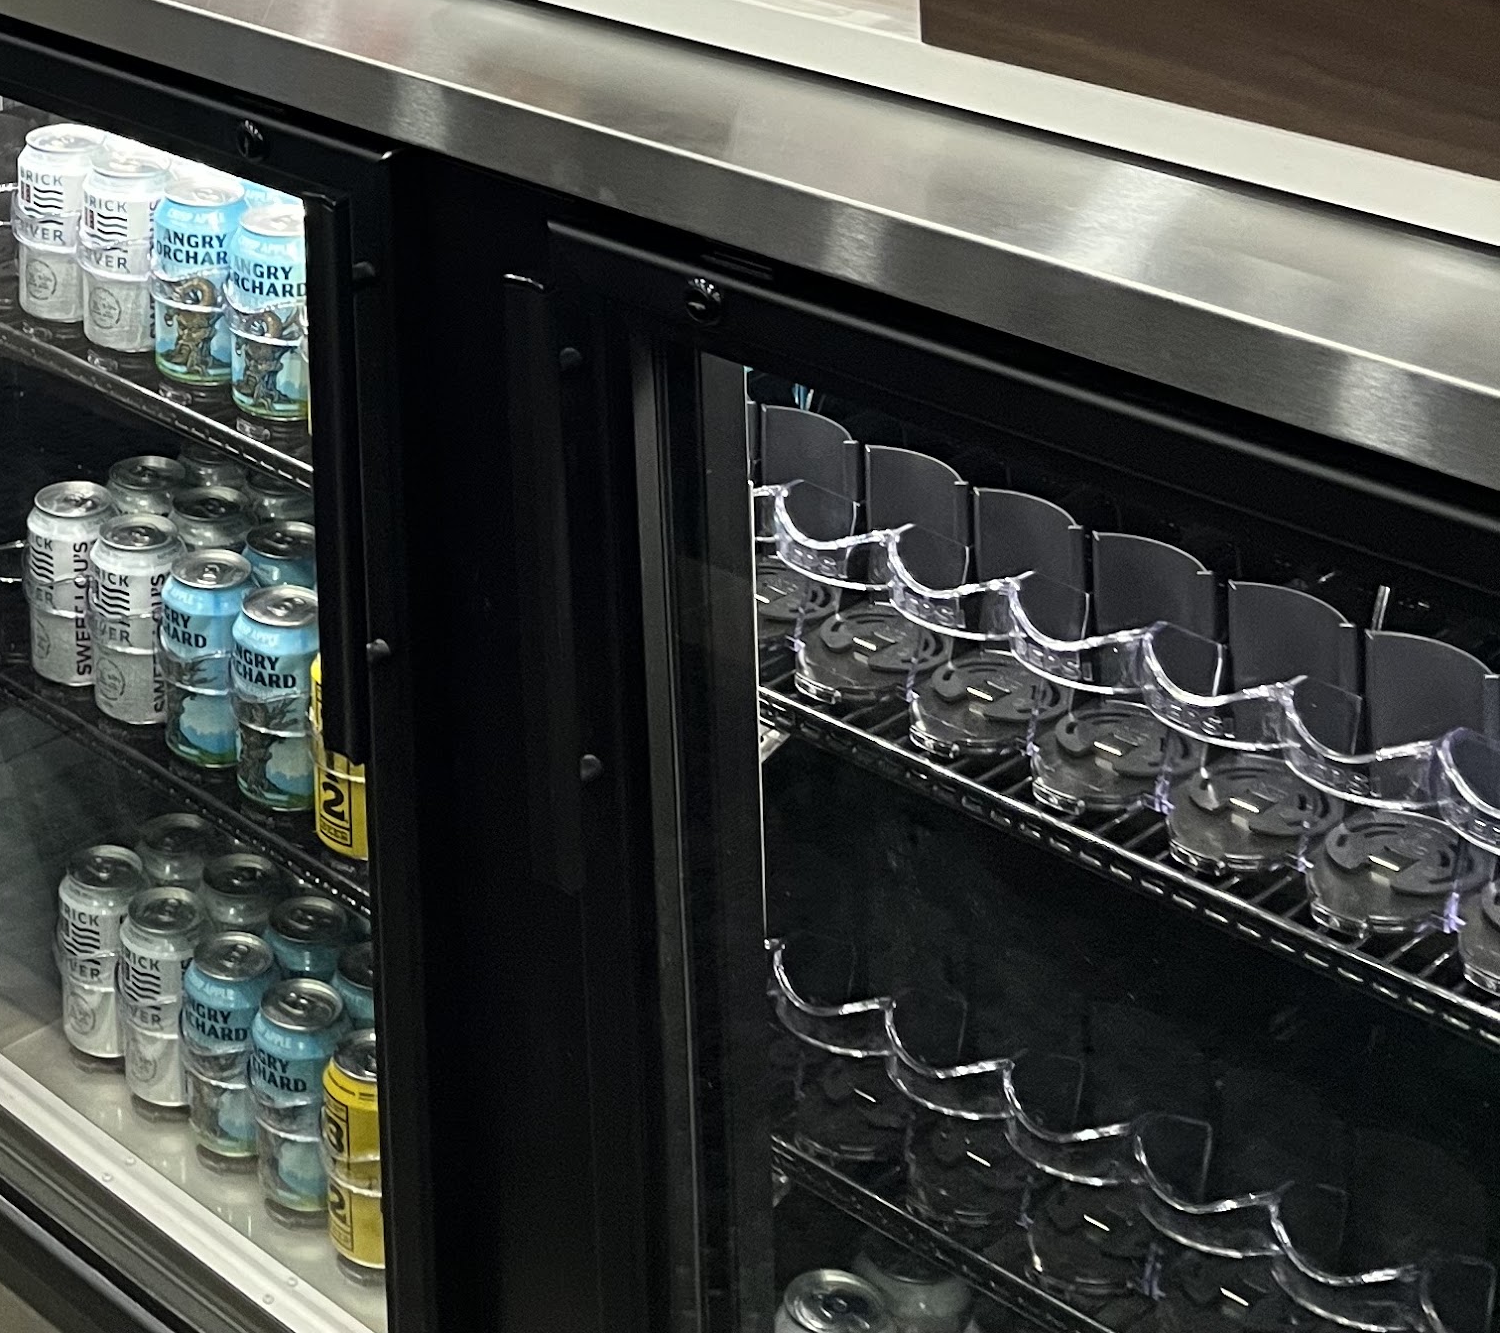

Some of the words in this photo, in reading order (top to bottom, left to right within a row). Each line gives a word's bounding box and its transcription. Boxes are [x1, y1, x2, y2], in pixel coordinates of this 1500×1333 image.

[20, 167, 64, 188] BRICK
[83, 193, 128, 214] BRICK
[164, 230, 228, 250] ANGRY
[156, 244, 230, 266] ORCHAR
